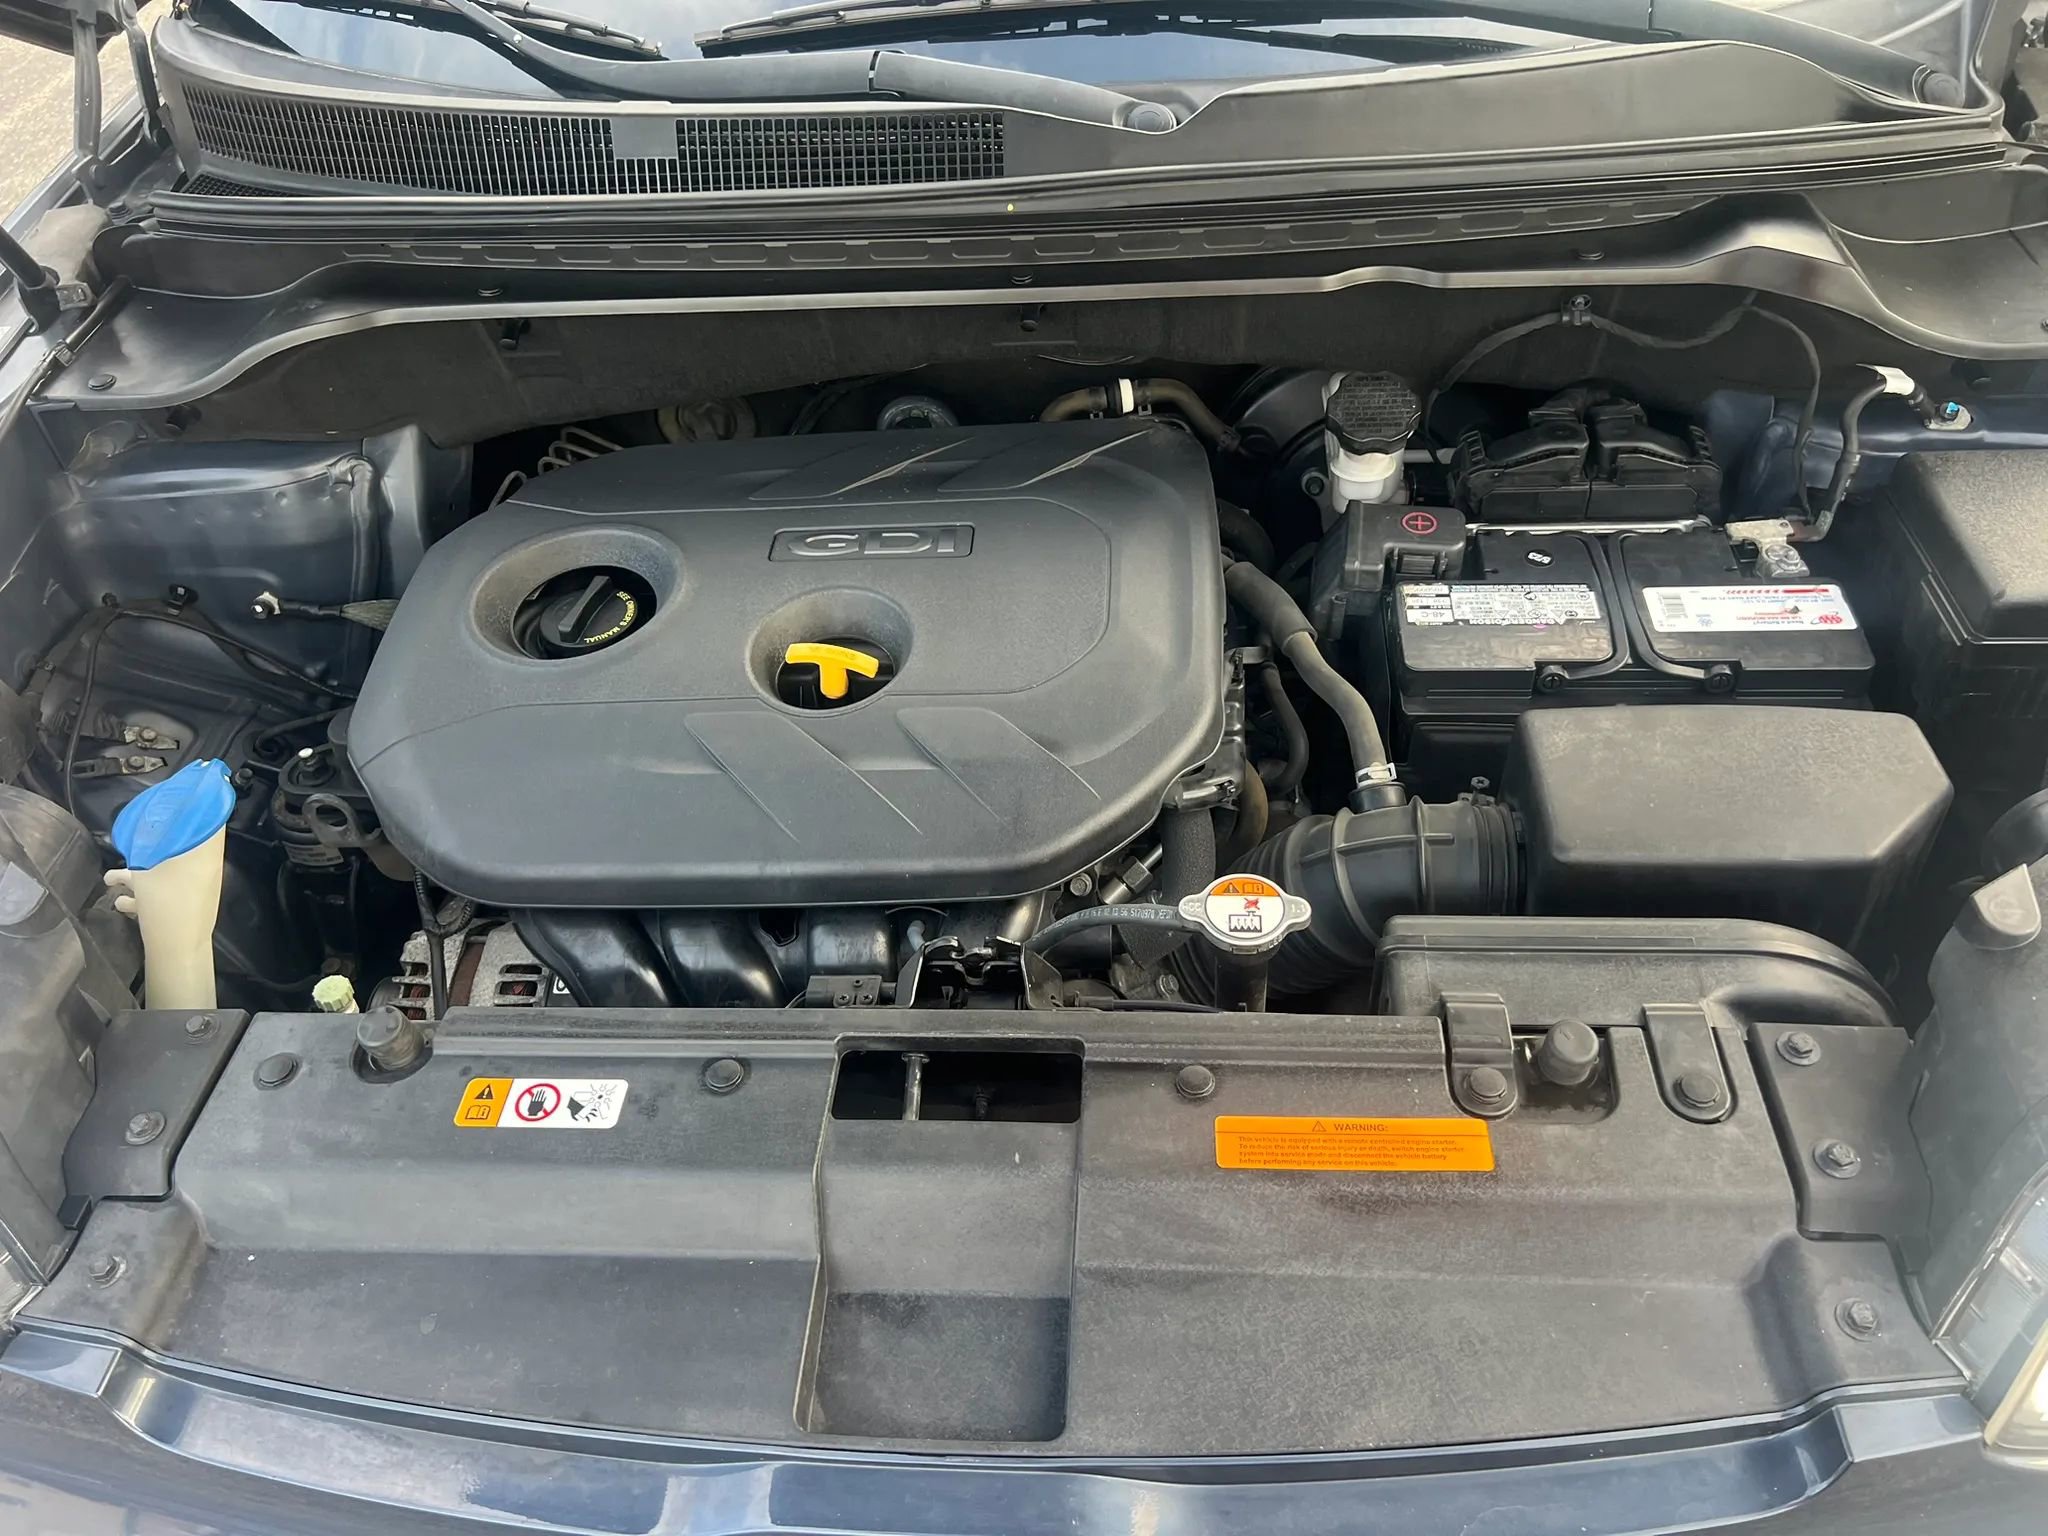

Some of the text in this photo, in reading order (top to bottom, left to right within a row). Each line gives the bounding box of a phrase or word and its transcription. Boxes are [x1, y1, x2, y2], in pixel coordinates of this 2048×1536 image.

[584, 591, 635, 643] SEE OWNER'S MANUAL
[1334, 1123, 1387, 1132] WARNING:
